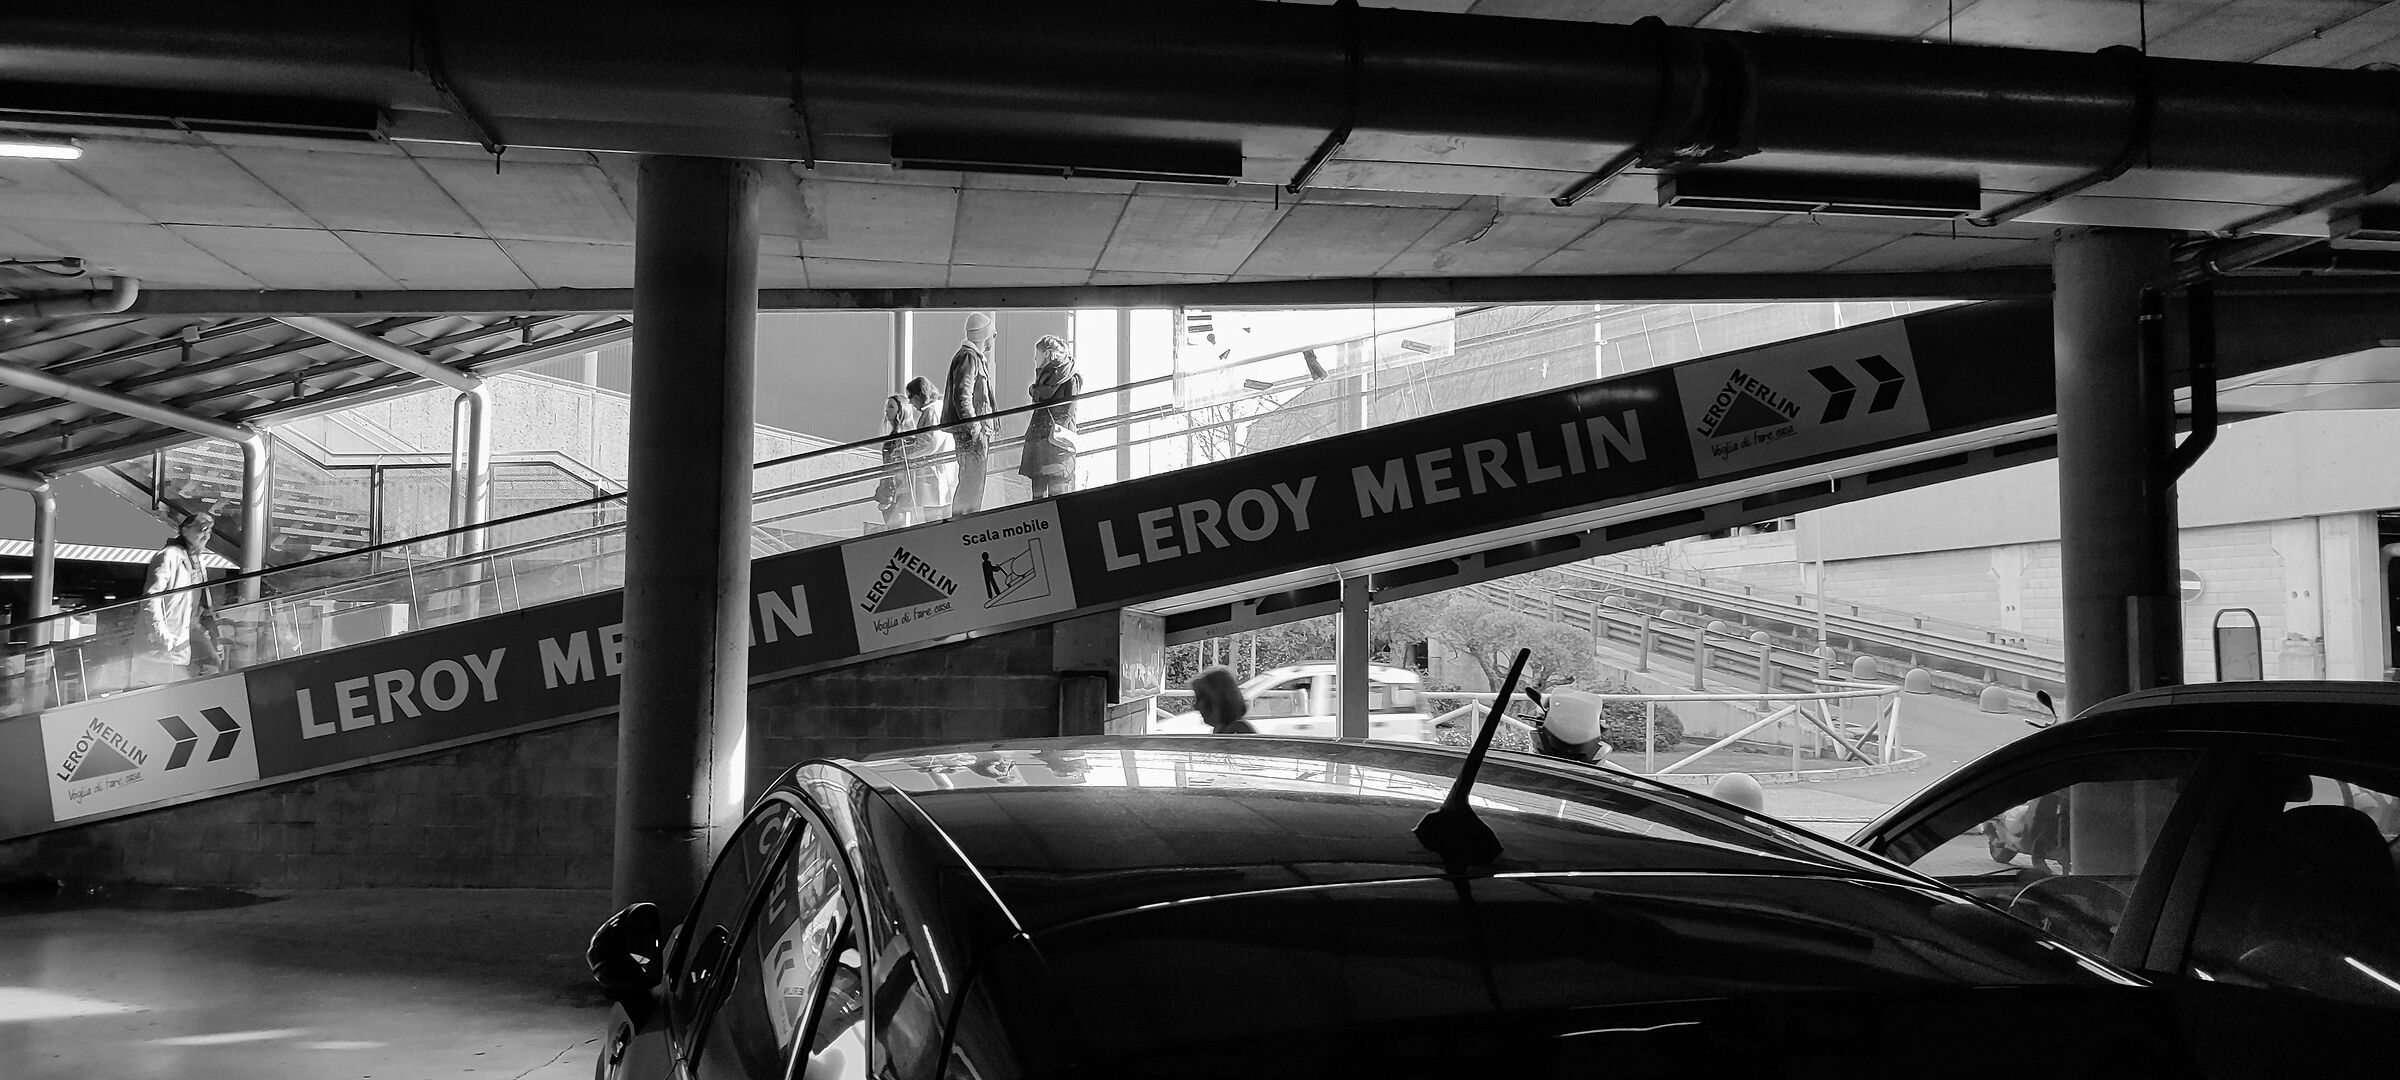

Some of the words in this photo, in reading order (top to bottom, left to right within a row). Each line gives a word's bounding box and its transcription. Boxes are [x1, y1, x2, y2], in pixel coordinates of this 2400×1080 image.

[1696, 381, 1738, 438] LEROY
[1728, 368, 1800, 419] MERLIN
[1098, 476, 1317, 572] LEROY
[1351, 409, 1647, 518] MERLIN
[962, 528, 1001, 547] Scala
[1003, 519, 1050, 538] mobile
[860, 558, 900, 613] LEROY
[893, 546, 958, 596] MERLIN
[873, 616, 899, 636] Voglia
[296, 648, 507, 740] LEROY
[538, 584, 813, 689] MEN
[56, 729, 95, 782] LEROY
[88, 716, 148, 766] MERLIN
